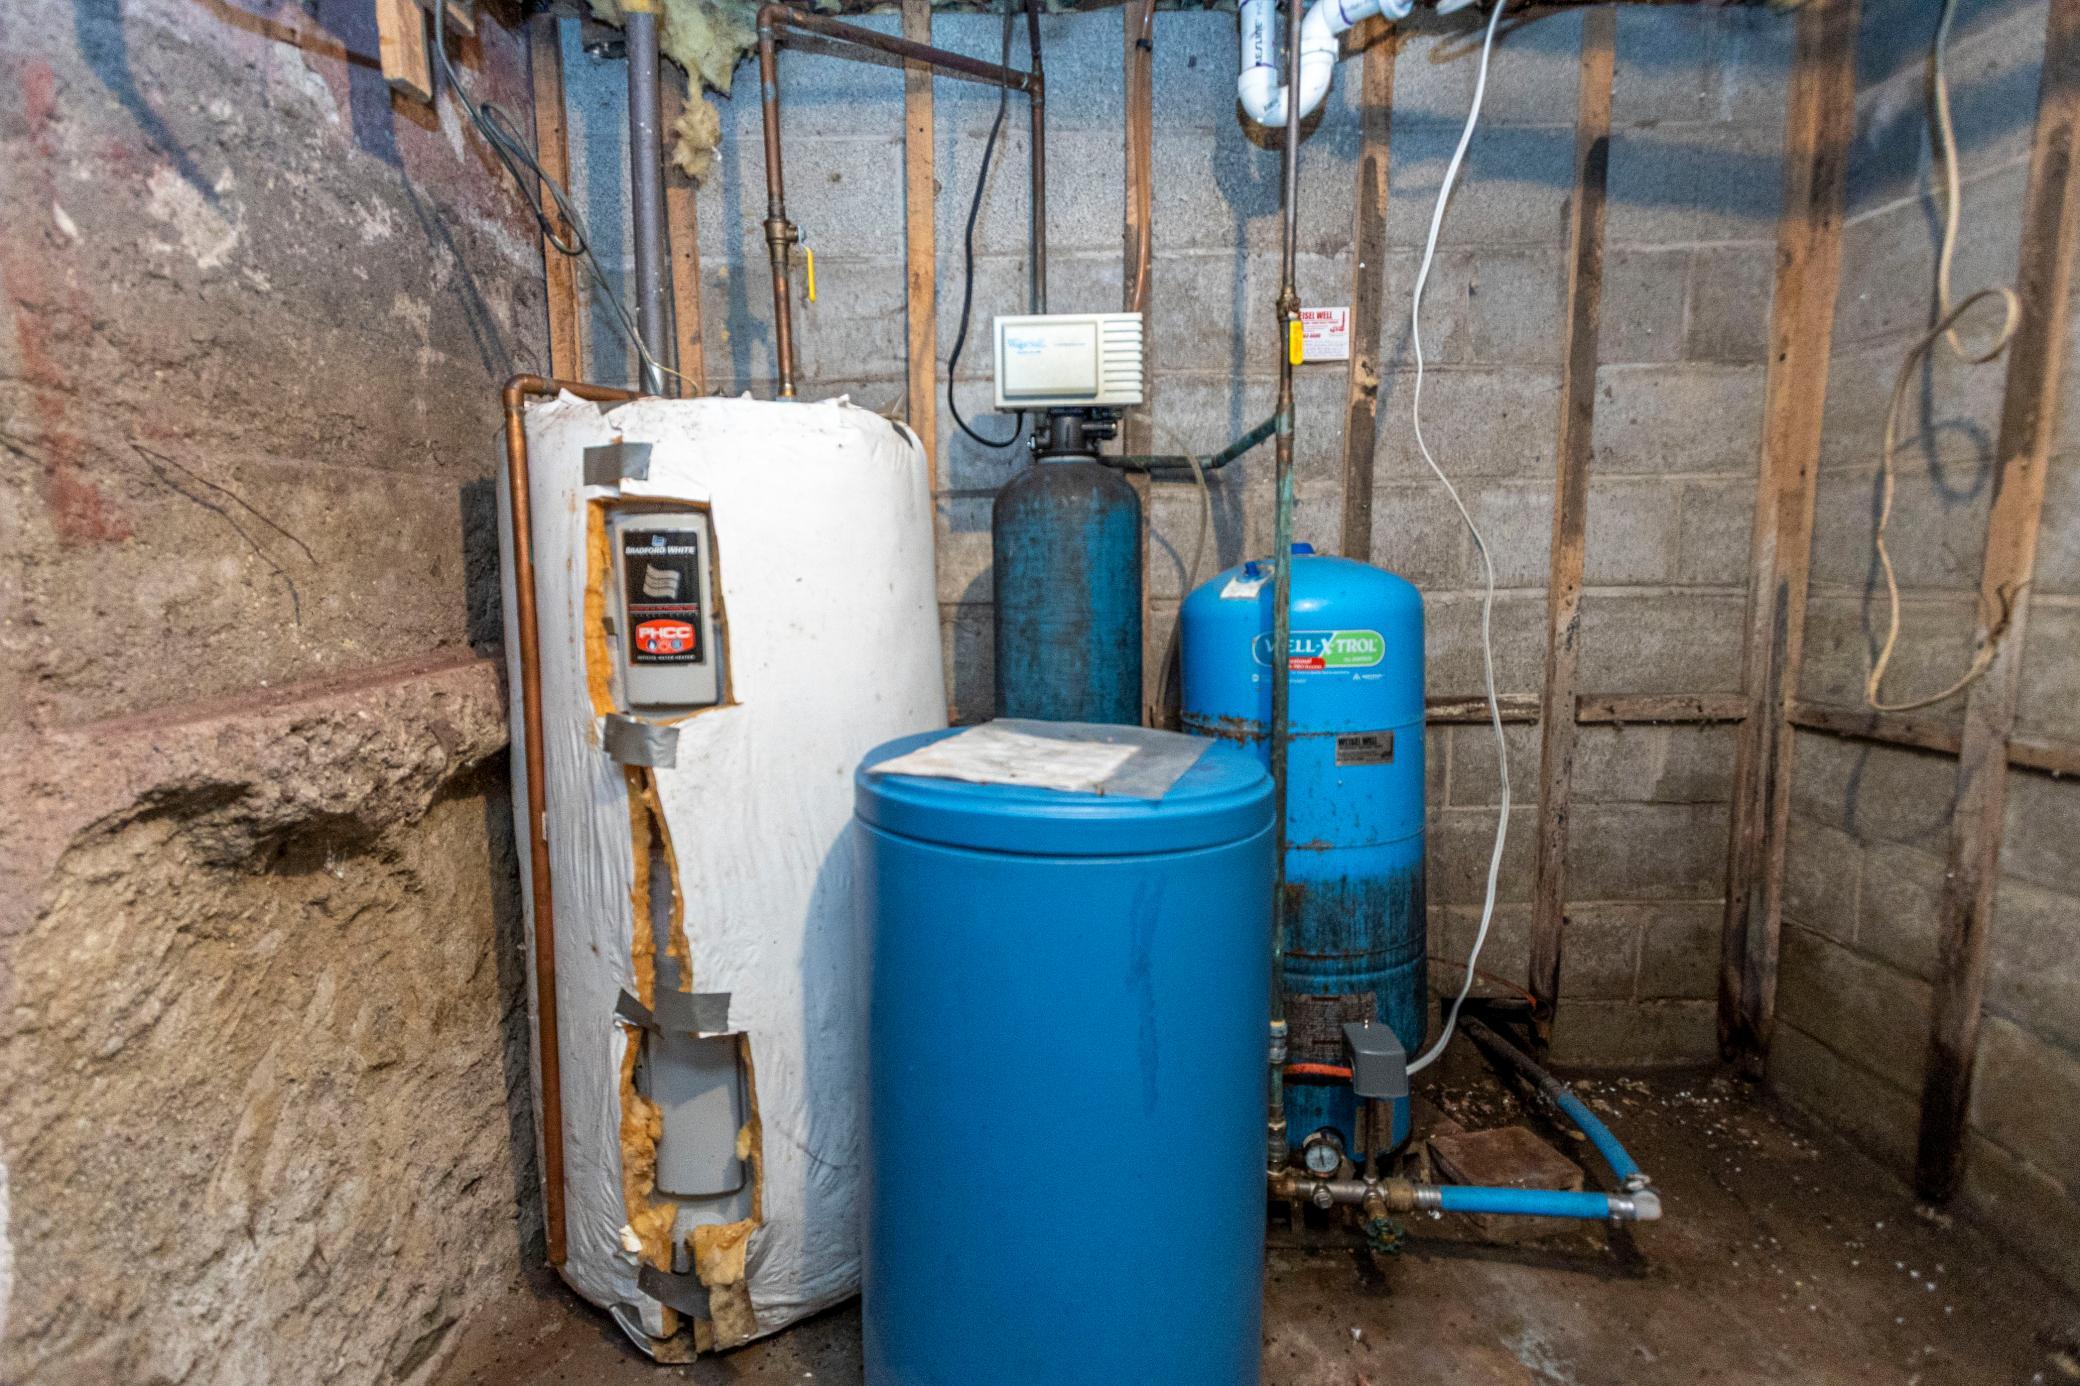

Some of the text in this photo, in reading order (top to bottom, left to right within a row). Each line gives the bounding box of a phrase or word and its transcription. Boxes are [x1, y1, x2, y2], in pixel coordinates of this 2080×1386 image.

[625, 545, 696, 555] BRADFORD WHITE
[639, 626, 691, 639] PHCC
